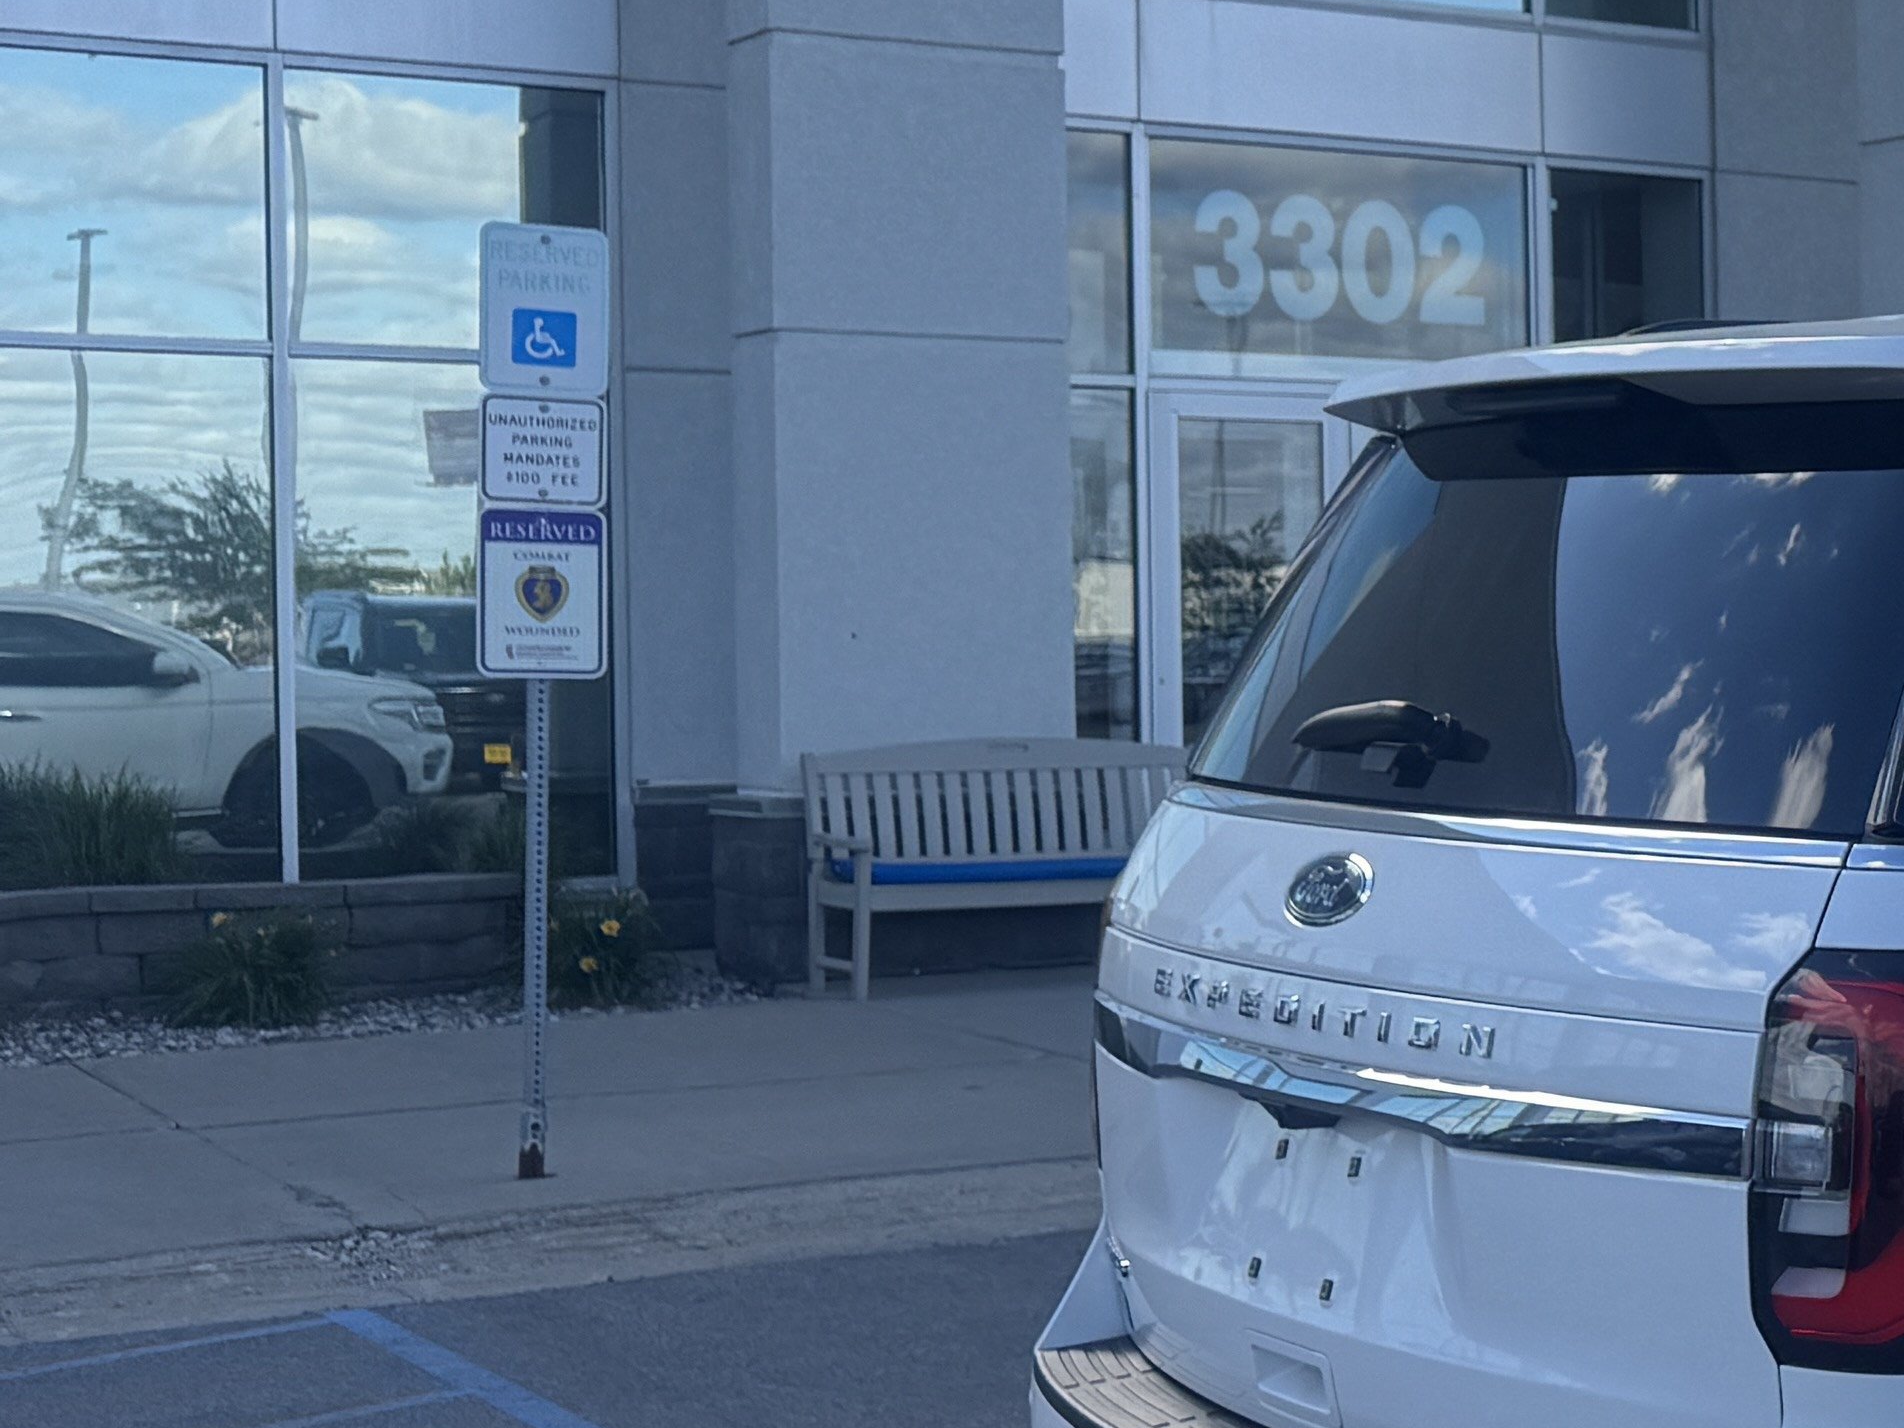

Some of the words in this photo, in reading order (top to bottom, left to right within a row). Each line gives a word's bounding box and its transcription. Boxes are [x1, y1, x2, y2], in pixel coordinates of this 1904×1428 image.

[490, 239, 598, 268] RESERVED
[1193, 188, 1486, 326] 3302
[498, 268, 592, 293] PARKING
[488, 413, 597, 432] UNAUTHORIZED
[511, 432, 573, 449] PARKING
[503, 452, 581, 469] MANDATES
[506, 471, 542, 485] $100
[551, 473, 579, 487] FEE
[490, 521, 597, 542] RESERVED
[513, 550, 572, 563] COMBAT
[504, 624, 581, 639] WOUNDED
[1153, 967, 1497, 1059] EXPEDITION
